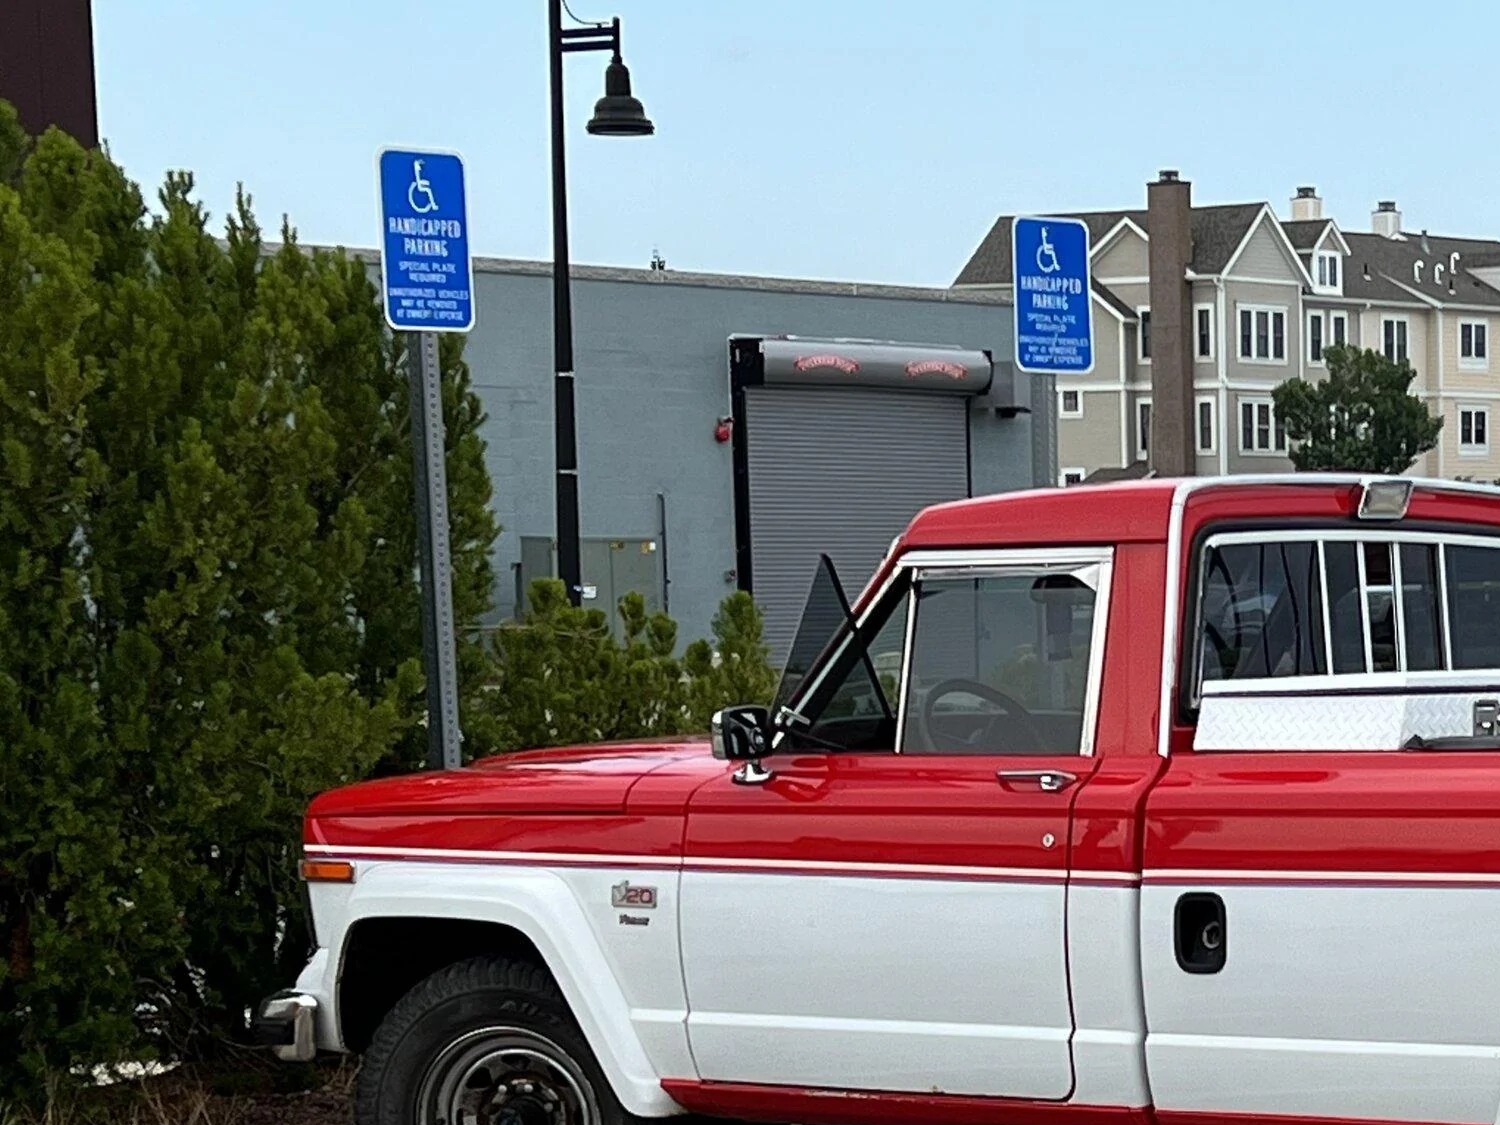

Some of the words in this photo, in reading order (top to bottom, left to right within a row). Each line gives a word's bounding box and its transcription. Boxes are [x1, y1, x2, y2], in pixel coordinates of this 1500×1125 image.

[389, 217, 461, 239] HANDICAPPED
[404, 237, 449, 257] PARKING
[1020, 275, 1082, 295] HANDICAPPED
[1032, 293, 1069, 310] PARKING
